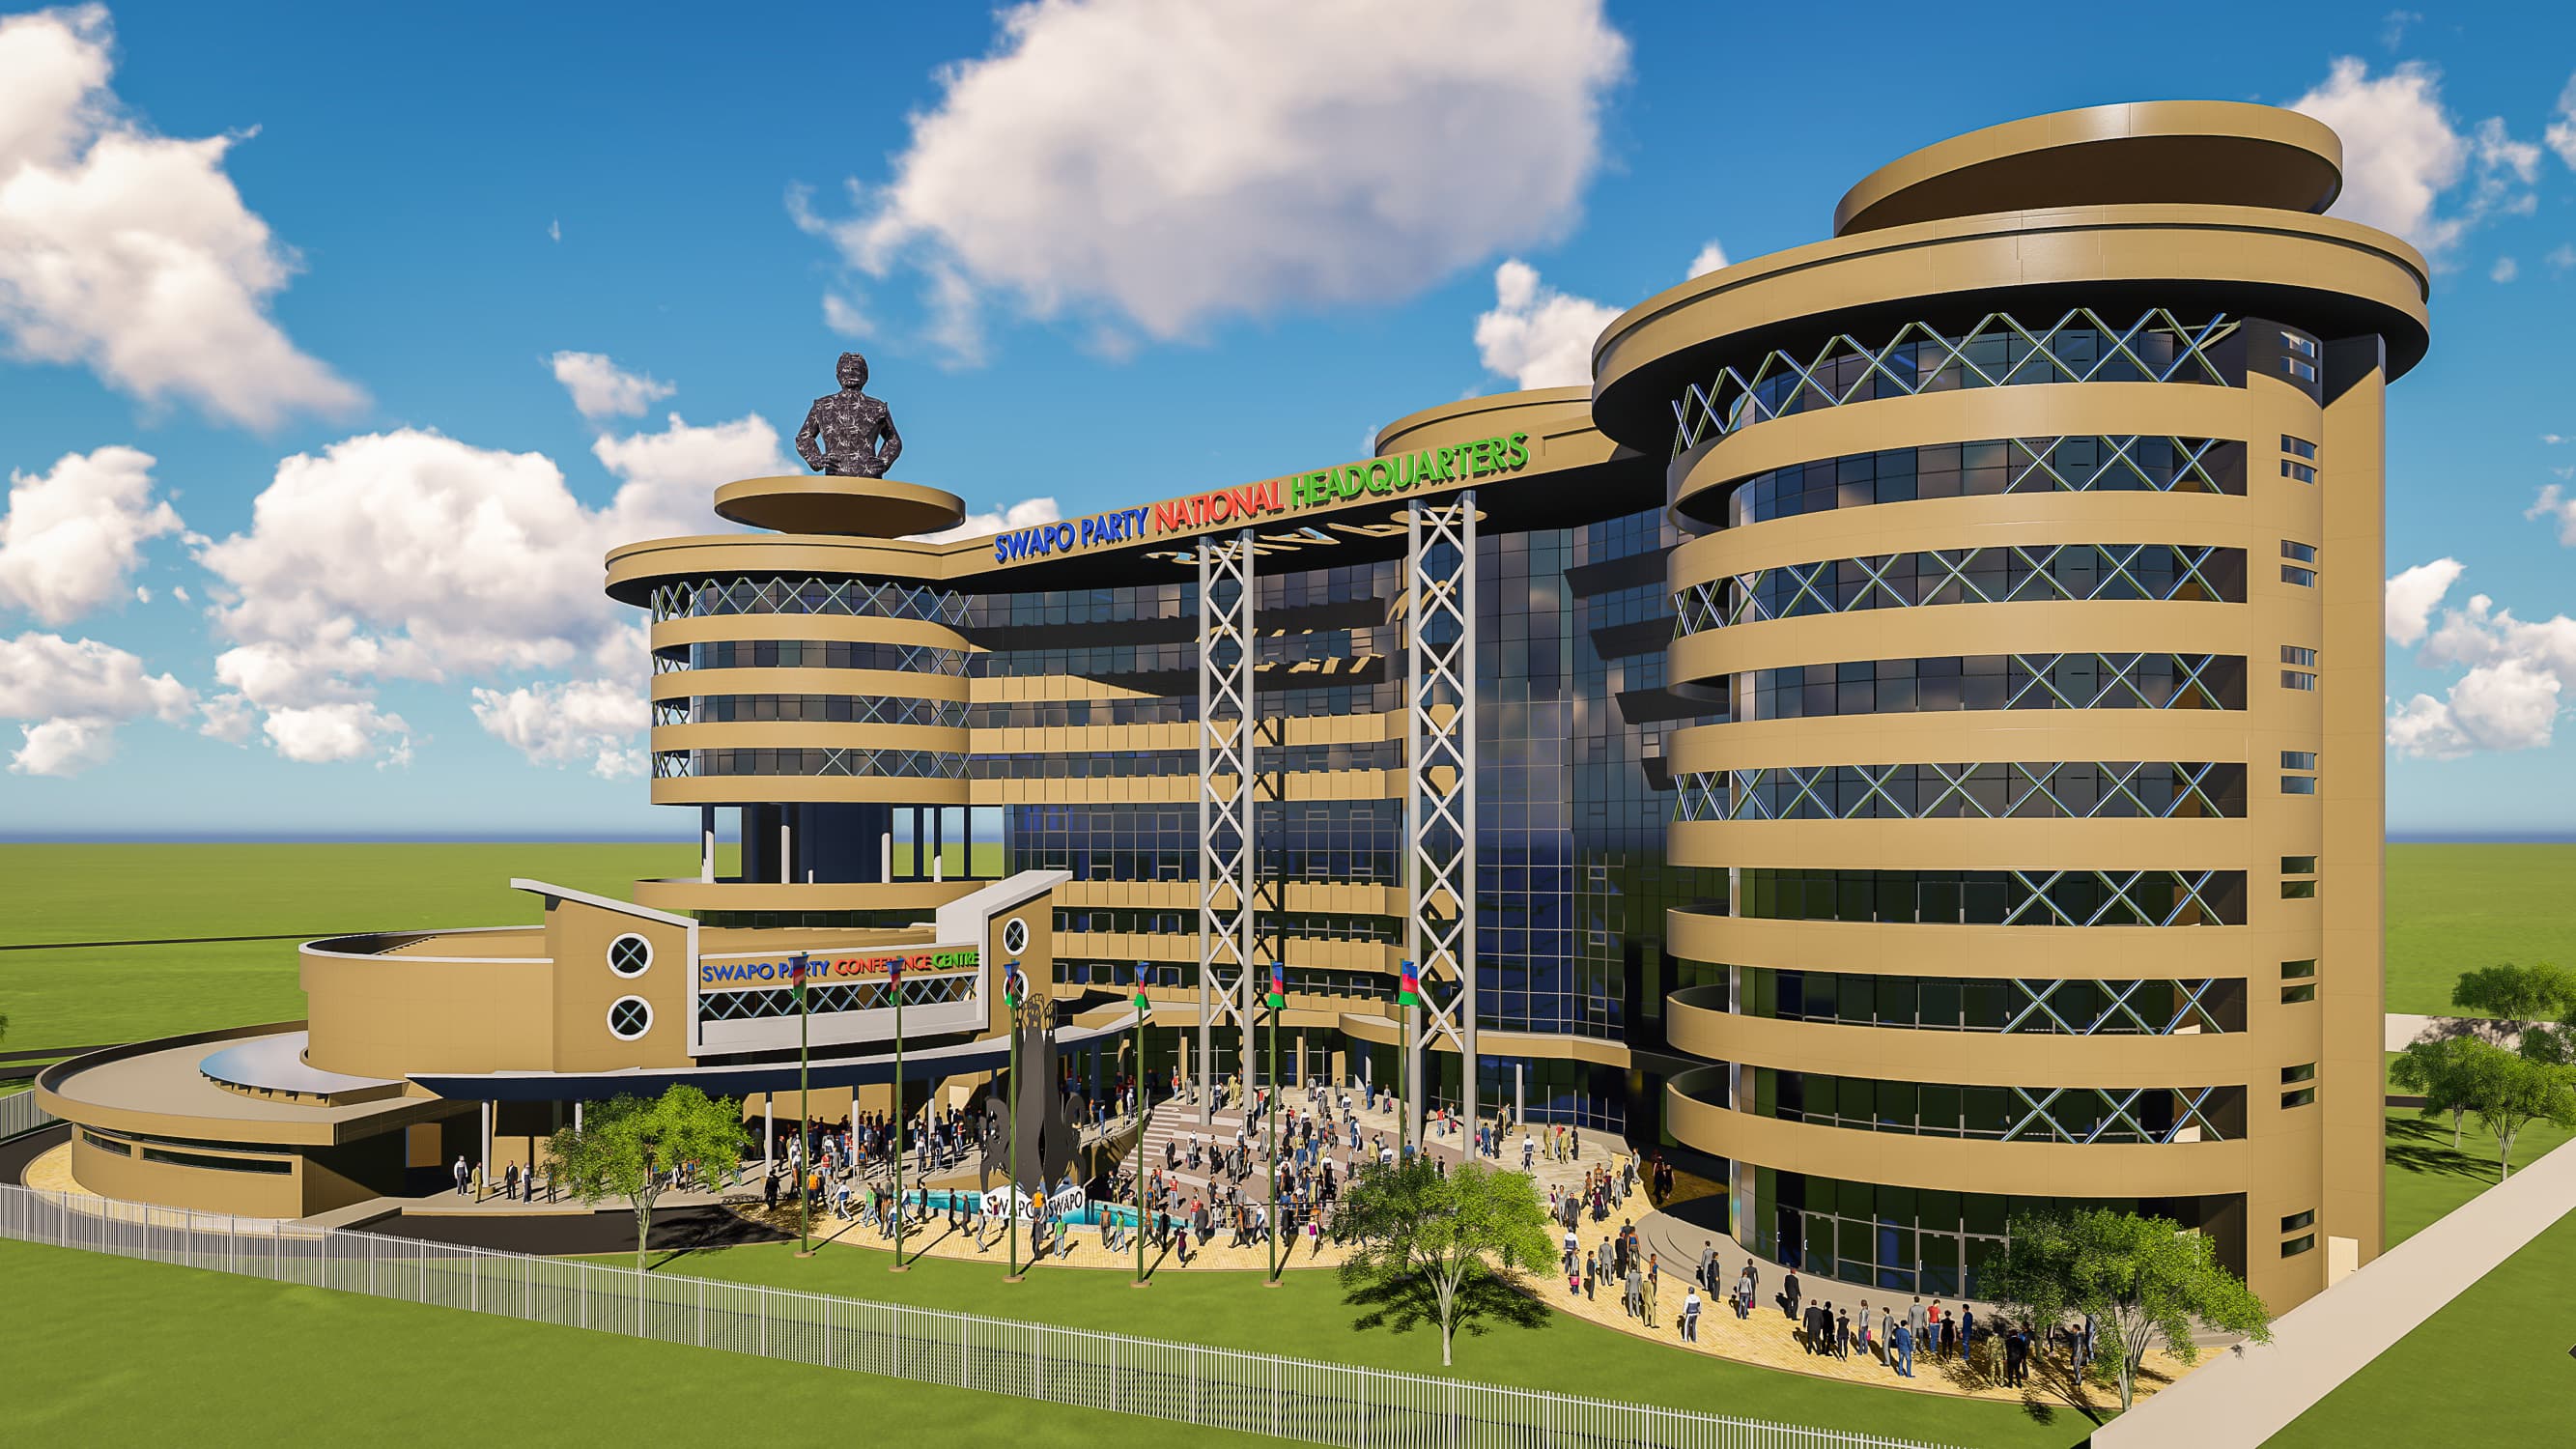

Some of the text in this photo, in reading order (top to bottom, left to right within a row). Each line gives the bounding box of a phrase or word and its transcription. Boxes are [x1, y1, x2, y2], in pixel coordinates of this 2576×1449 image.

[995, 432, 1530, 563] SWAPO PARTY NATIONAL HEADQUARTERS
[702, 951, 979, 982] SWAPO PRTY CONFENCE CENTRE
[986, 1196, 1035, 1219] SWPO
[1048, 1191, 1083, 1217] SWAPO
